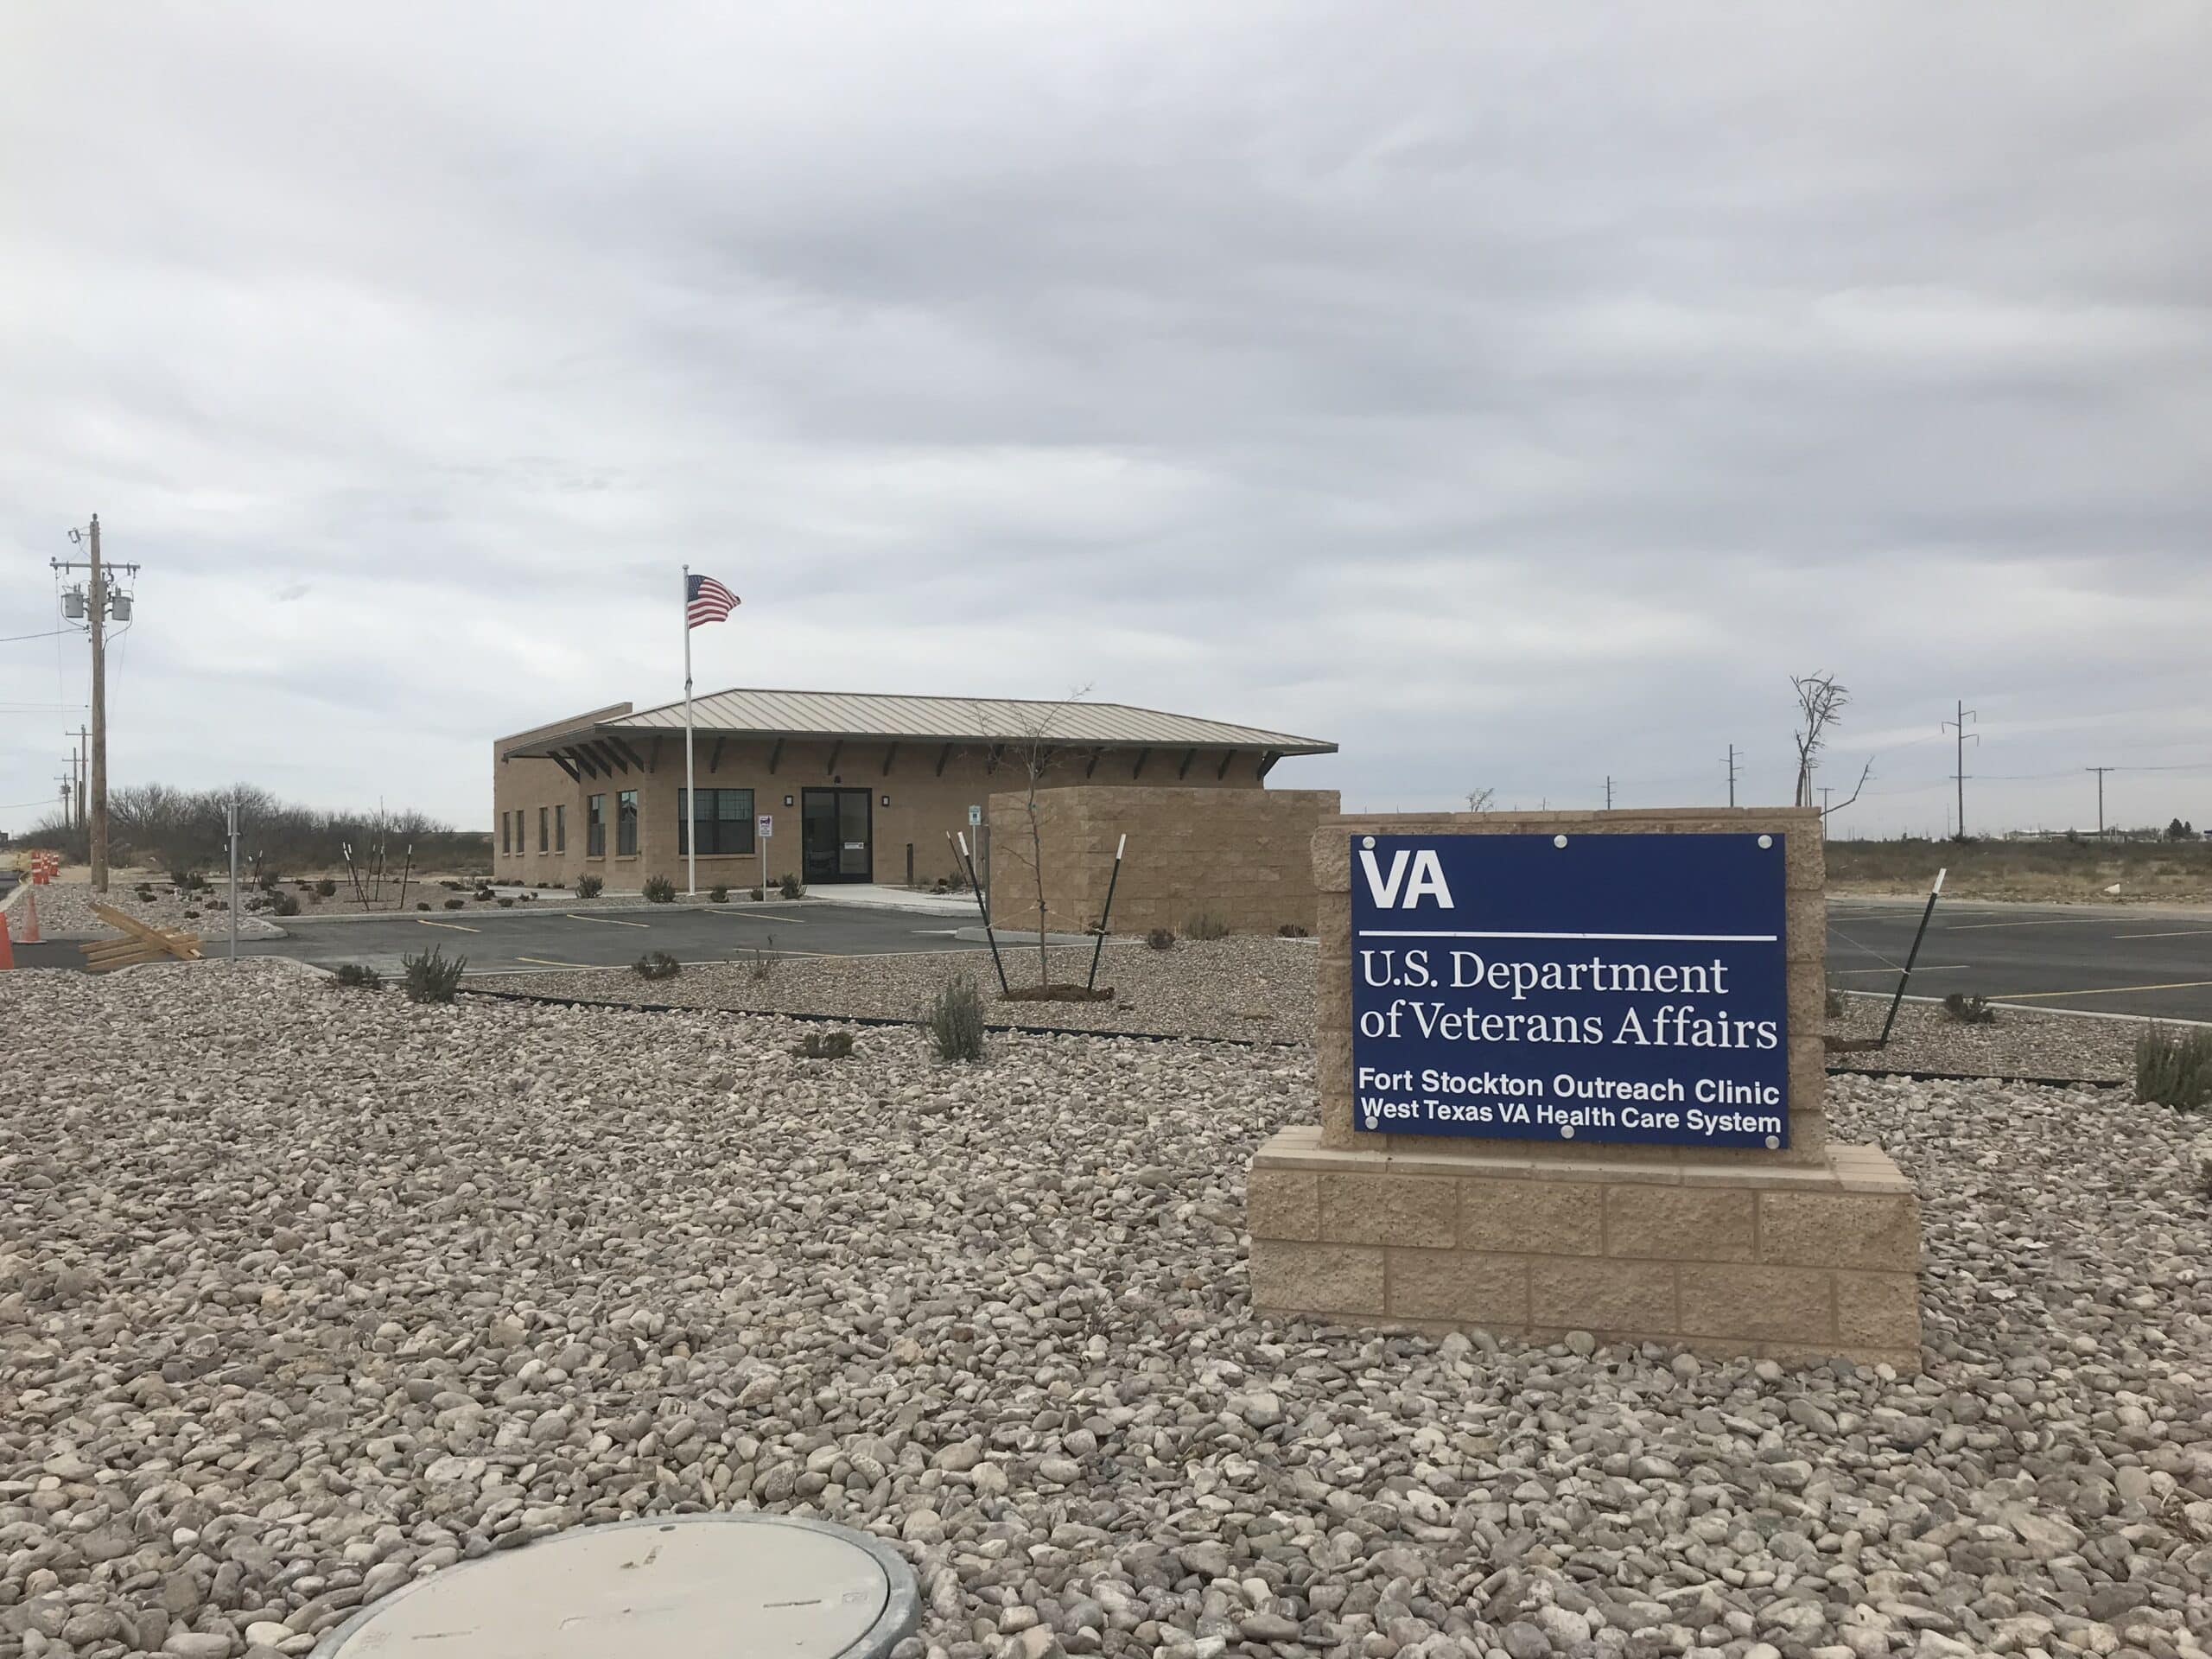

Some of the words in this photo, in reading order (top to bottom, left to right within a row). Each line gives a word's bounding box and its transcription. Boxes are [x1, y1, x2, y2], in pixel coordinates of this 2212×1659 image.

[1358, 849, 1455, 909] VA
[1359, 950, 1439, 988] U.S.
[1449, 950, 1729, 1000] Department
[1360, 999, 1407, 1039] of
[1408, 1001, 1604, 1046] Veterans
[1611, 1005, 1778, 1050] Affairs
[1358, 1067, 1414, 1091] Fort
[1421, 1069, 1543, 1096] Stockton
[1553, 1073, 1685, 1102] Outreach
[1694, 1078, 1780, 1105] Clinic
[1361, 1096, 1420, 1119] West
[1423, 1099, 1493, 1122] Texas
[1497, 1103, 1531, 1124] VA
[1537, 1104, 1616, 1127] Health
[1621, 1107, 1680, 1128] Care
[1687, 1109, 1782, 1136] System
